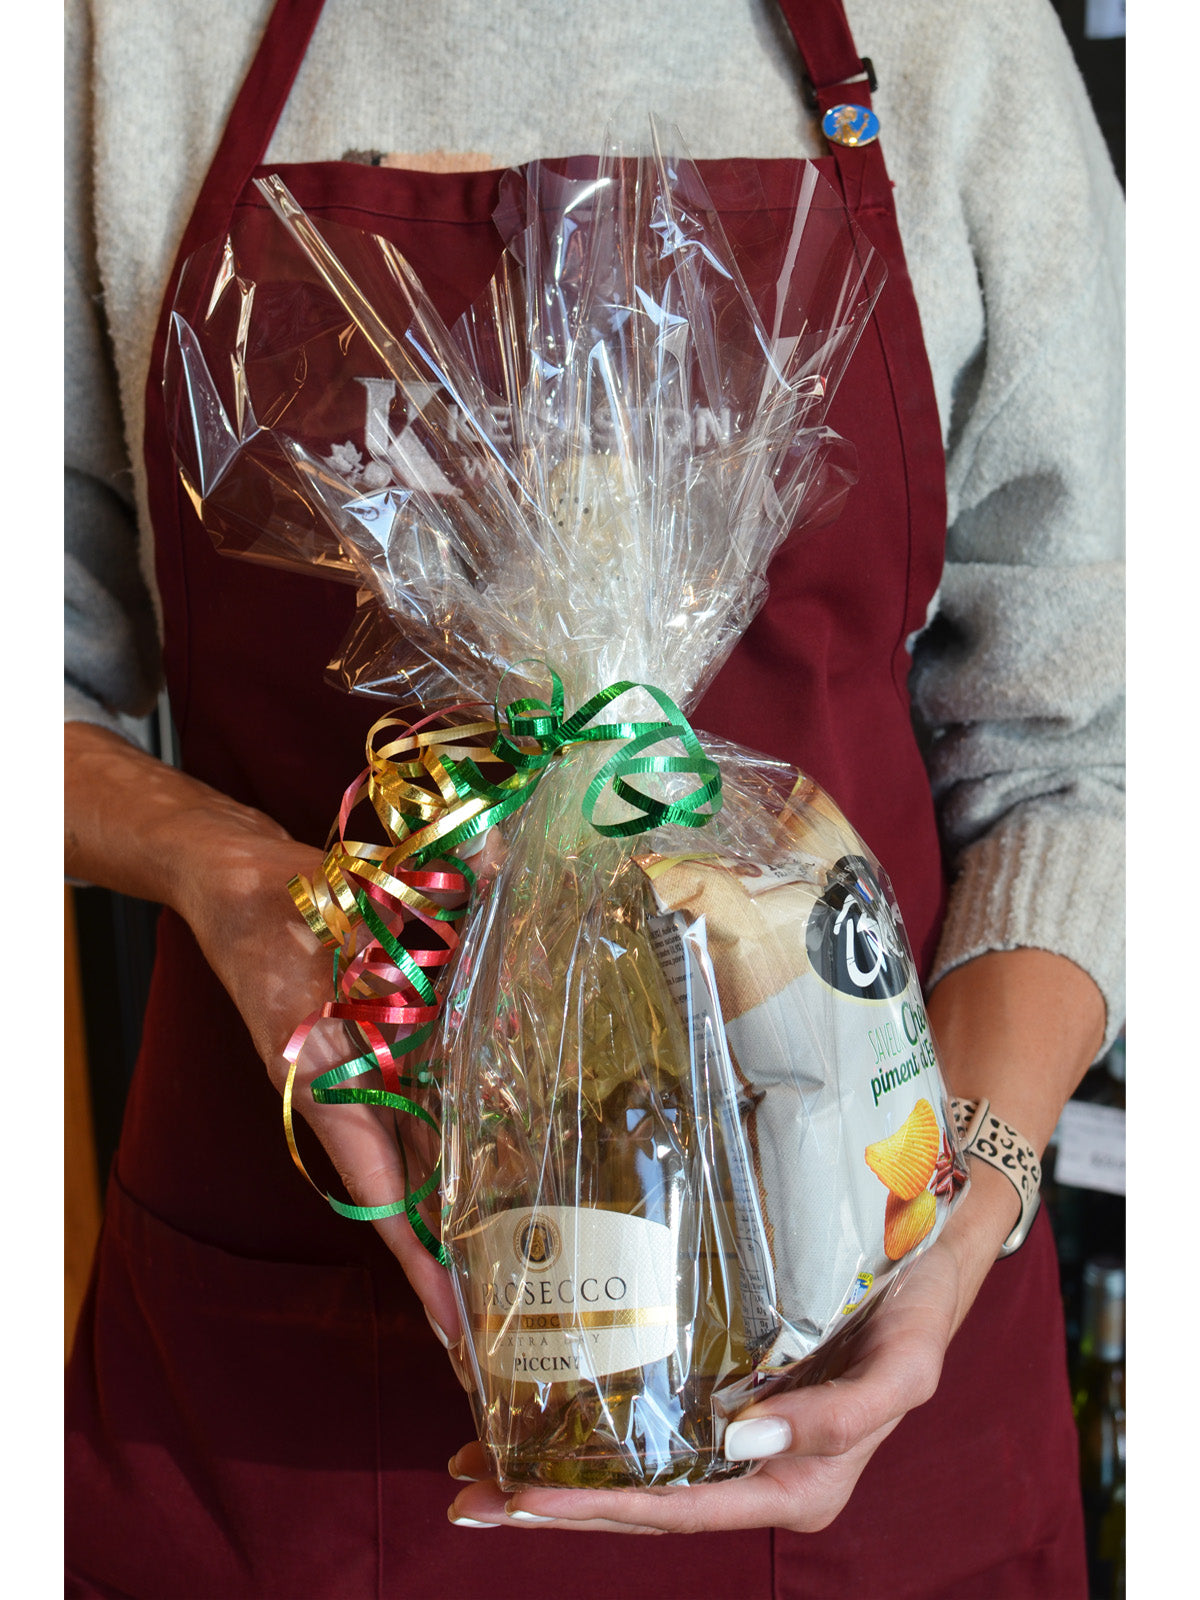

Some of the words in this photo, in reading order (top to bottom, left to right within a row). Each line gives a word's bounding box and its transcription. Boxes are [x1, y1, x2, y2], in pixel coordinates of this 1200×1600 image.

[870, 1052, 920, 1108] piment
[482, 1276, 627, 1306] PROSECCO
[526, 1316, 561, 1329] DOC
[500, 1336, 548, 1347] XTRA
